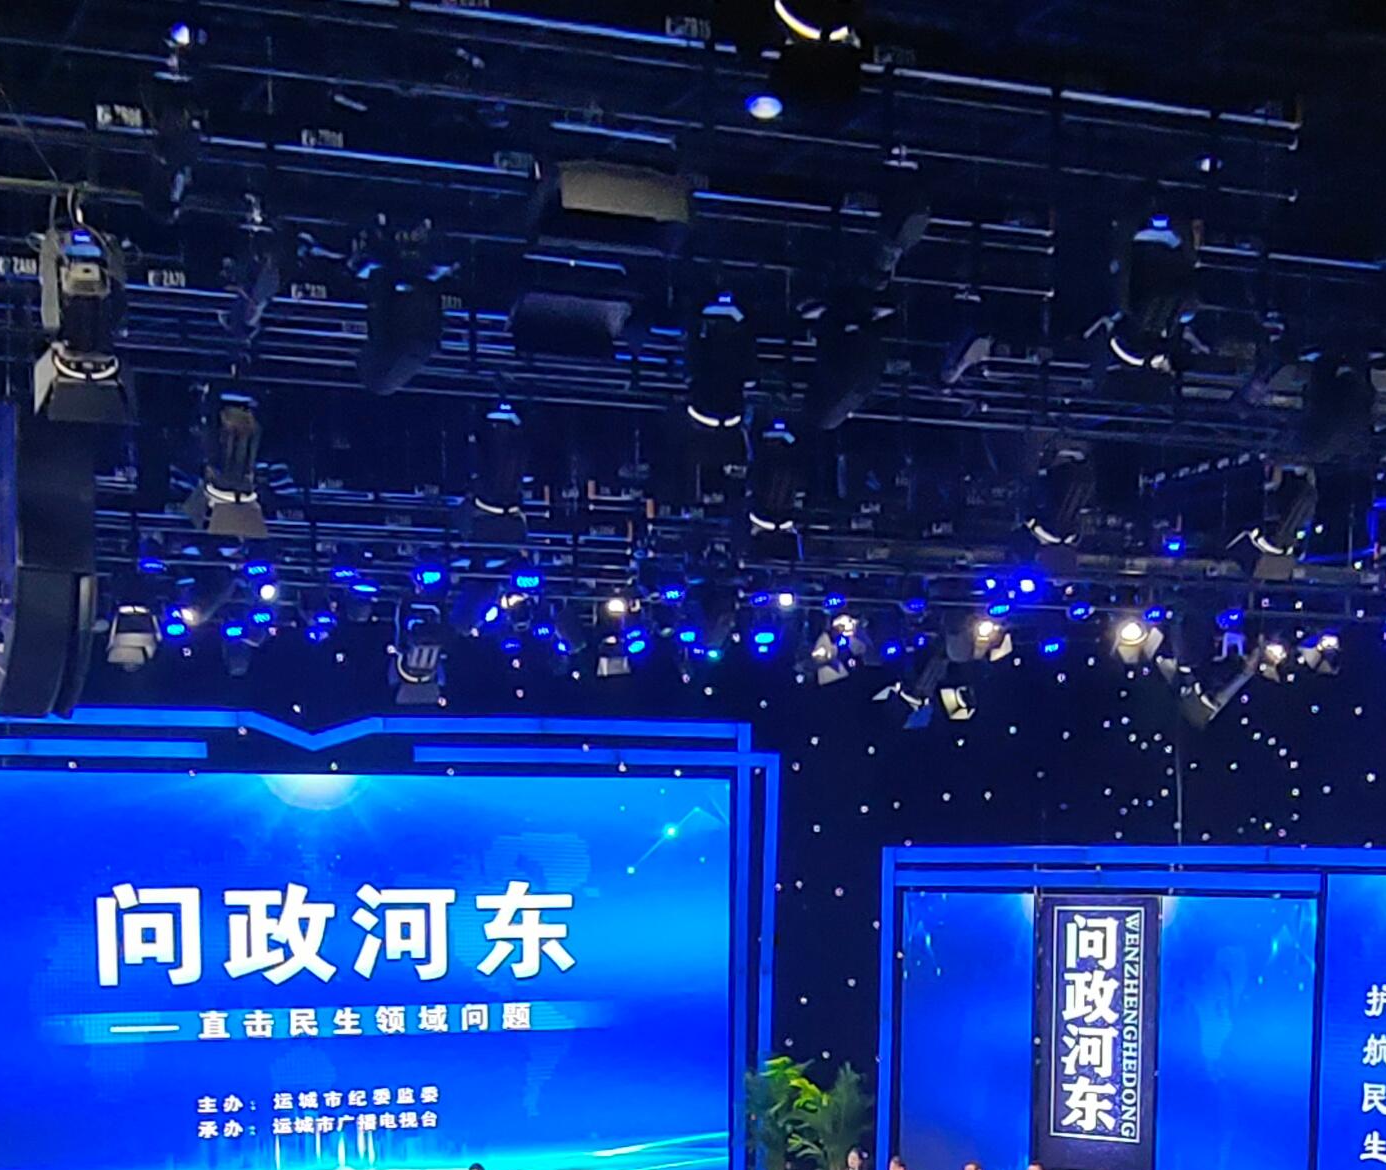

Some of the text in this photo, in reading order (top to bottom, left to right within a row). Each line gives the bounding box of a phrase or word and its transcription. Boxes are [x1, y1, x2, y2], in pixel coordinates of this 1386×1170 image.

[96, 881, 576, 986] 问政河东
[198, 1002, 533, 1039] 直击民生领域问题
[1061, 914, 1119, 1132] 问政河东
[1121, 912, 1141, 1138] WENZHENGHEDONG
